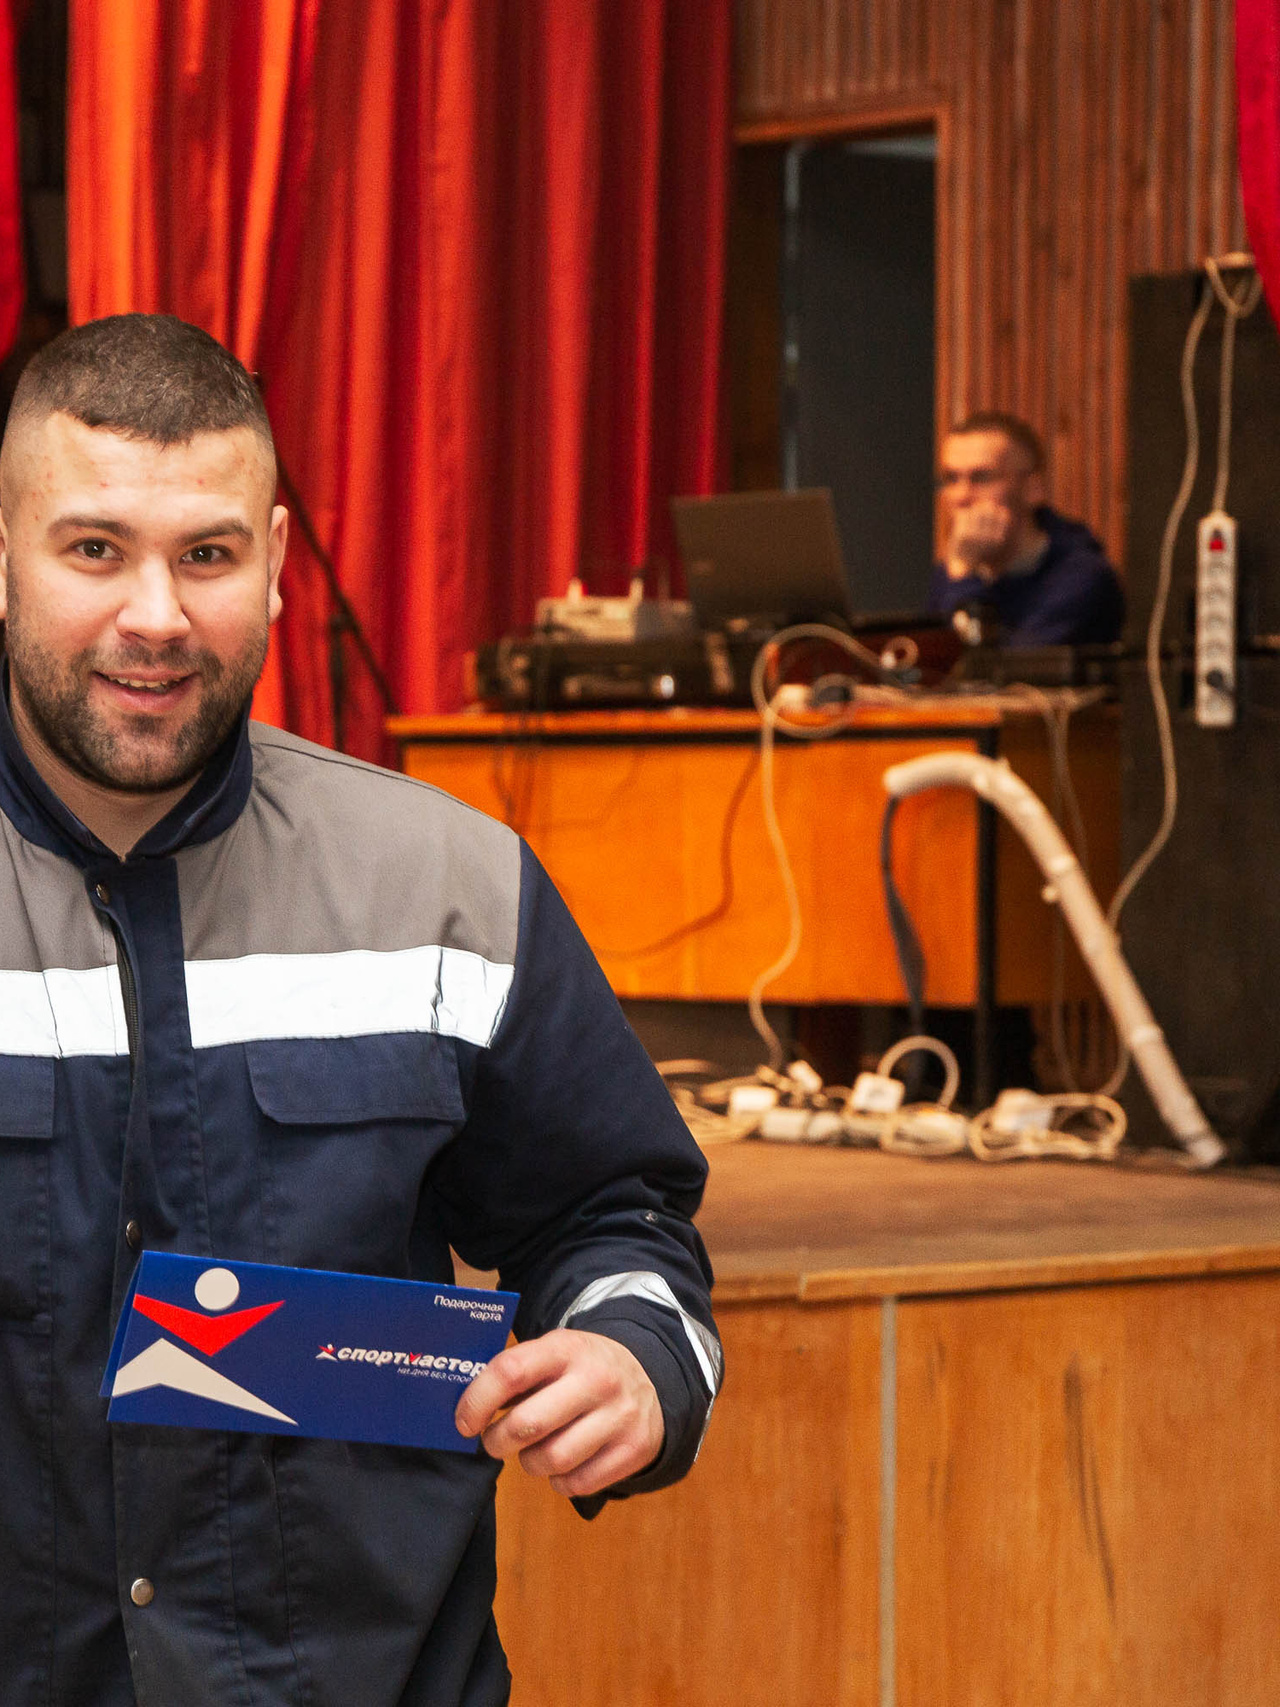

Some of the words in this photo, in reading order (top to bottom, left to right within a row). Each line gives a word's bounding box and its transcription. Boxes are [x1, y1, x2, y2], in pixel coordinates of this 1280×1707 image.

[433, 1295, 505, 1312] Подарочная
[469, 1310, 502, 1321] карта
[410, 1368, 429, 1377] ДНЯ
[430, 1371, 447, 1380] БЕЗ
[447, 1374, 473, 1384] СПОР
